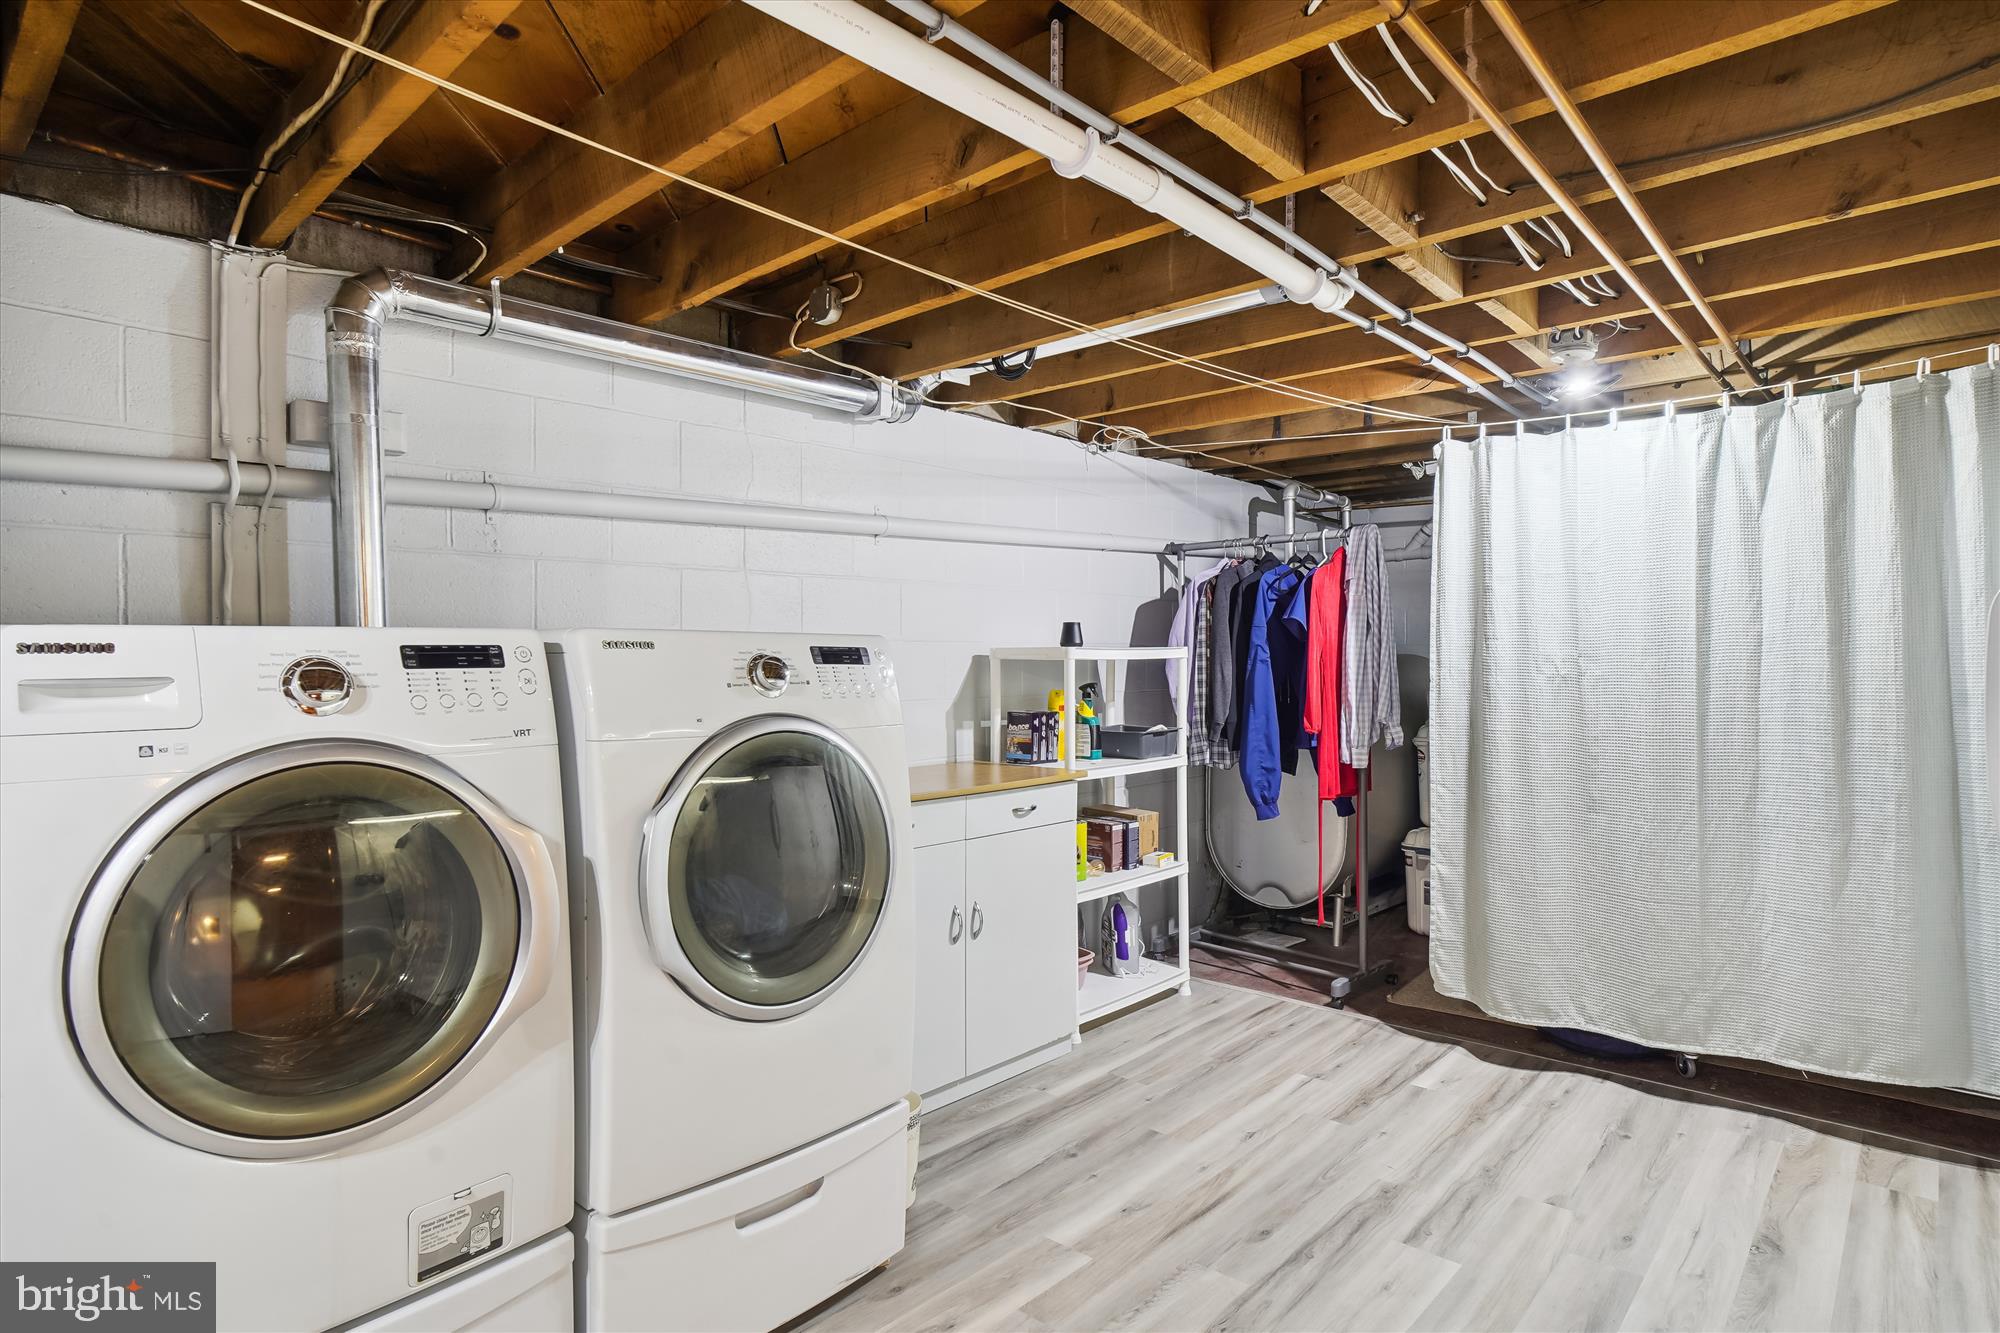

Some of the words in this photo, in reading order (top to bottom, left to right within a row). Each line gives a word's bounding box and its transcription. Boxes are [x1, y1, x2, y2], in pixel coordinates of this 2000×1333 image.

[15, 642, 115, 654] SAMSUNG
[602, 640, 655, 649] SAMSUNG
[513, 729, 532, 737] VRT
